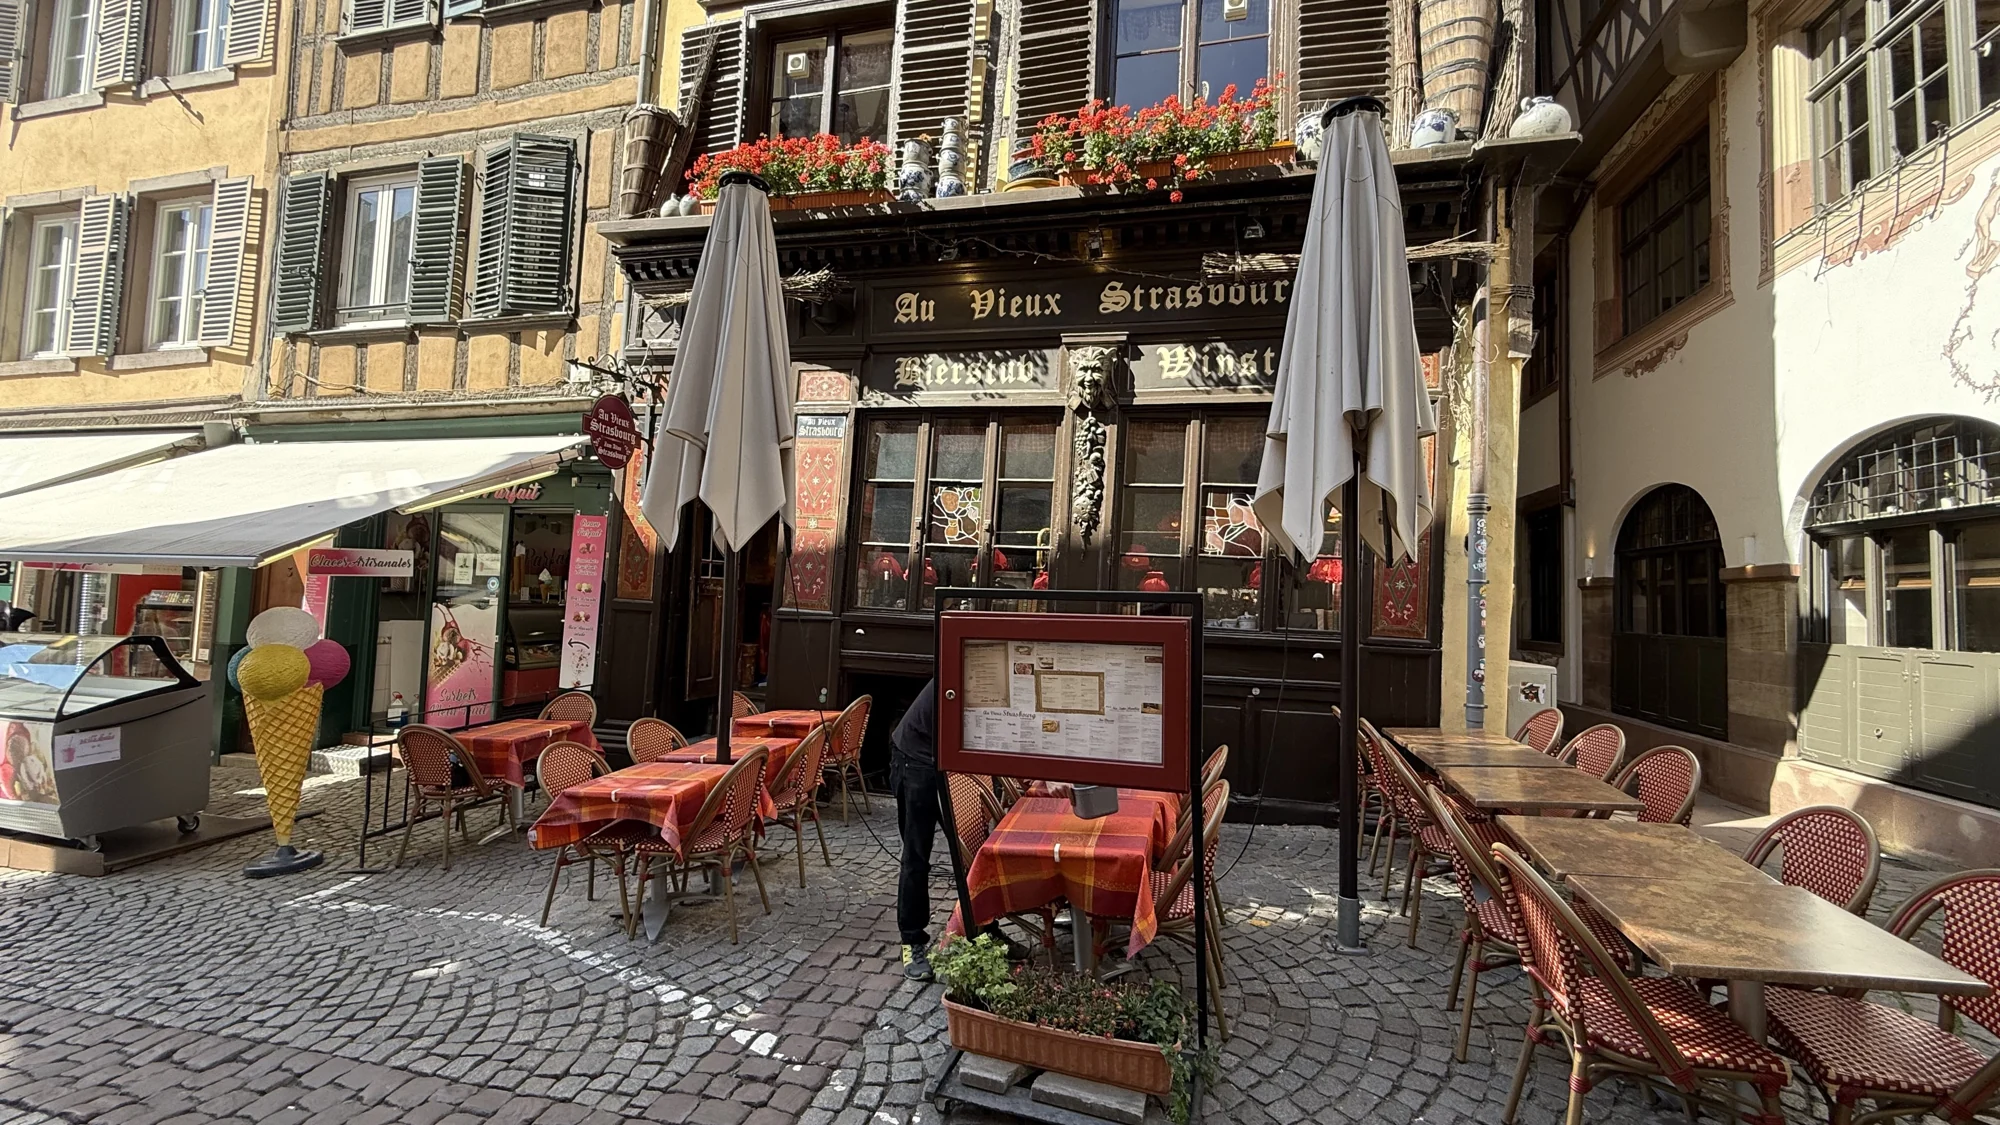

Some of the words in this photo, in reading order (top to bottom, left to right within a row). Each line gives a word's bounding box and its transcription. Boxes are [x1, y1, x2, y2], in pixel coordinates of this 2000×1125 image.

[893, 292, 936, 324] Au
[969, 287, 1062, 321] Vieux
[1098, 279, 1290, 314] Strasbour
[894, 354, 1034, 390] Bierstub
[1156, 345, 1276, 380] Winst
[598, 408, 609, 422] Au
[610, 412, 630, 428] Vieux
[590, 418, 636, 445] Strasbourg
[798, 425, 843, 438] Strasbourg
[482, 482, 542, 504] arfait
[309, 553, 348, 568] Glaces
[349, 555, 412, 568] Artisanales
[439, 687, 477, 702] Sorbets
